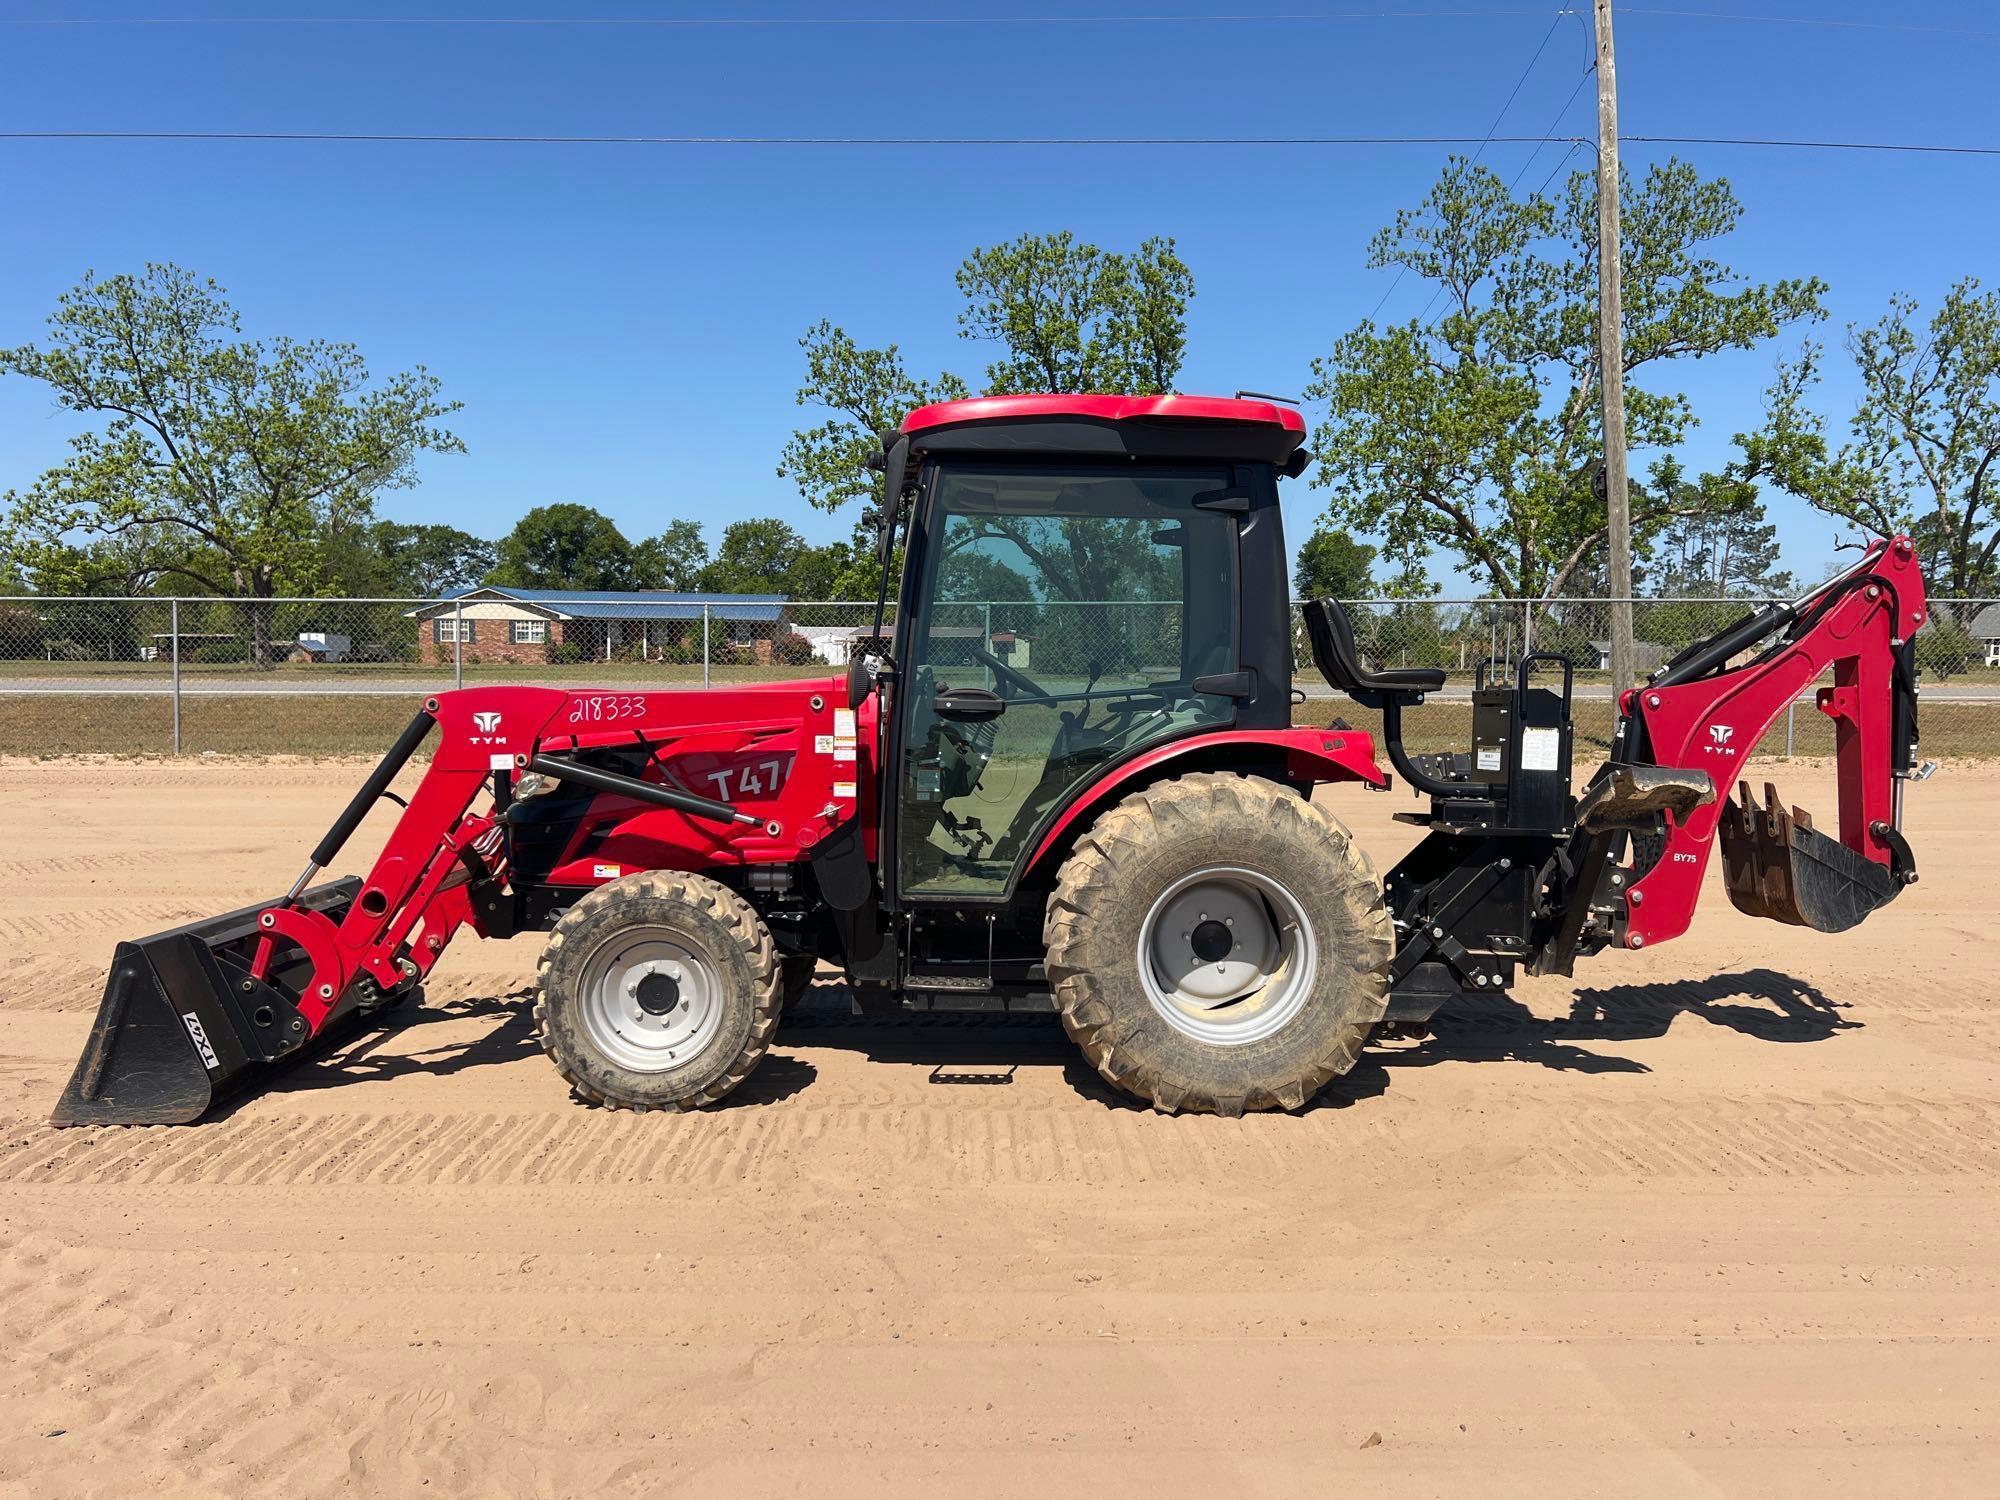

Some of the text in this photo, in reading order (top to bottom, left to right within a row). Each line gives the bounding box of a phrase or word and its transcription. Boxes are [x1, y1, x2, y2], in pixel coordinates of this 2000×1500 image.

[569, 696, 646, 723] 218333
[469, 737, 507, 745] TYM
[1704, 746, 1735, 755] TYM
[1673, 853, 1697, 863] BY75
[186, 1017, 214, 1065] TX47
